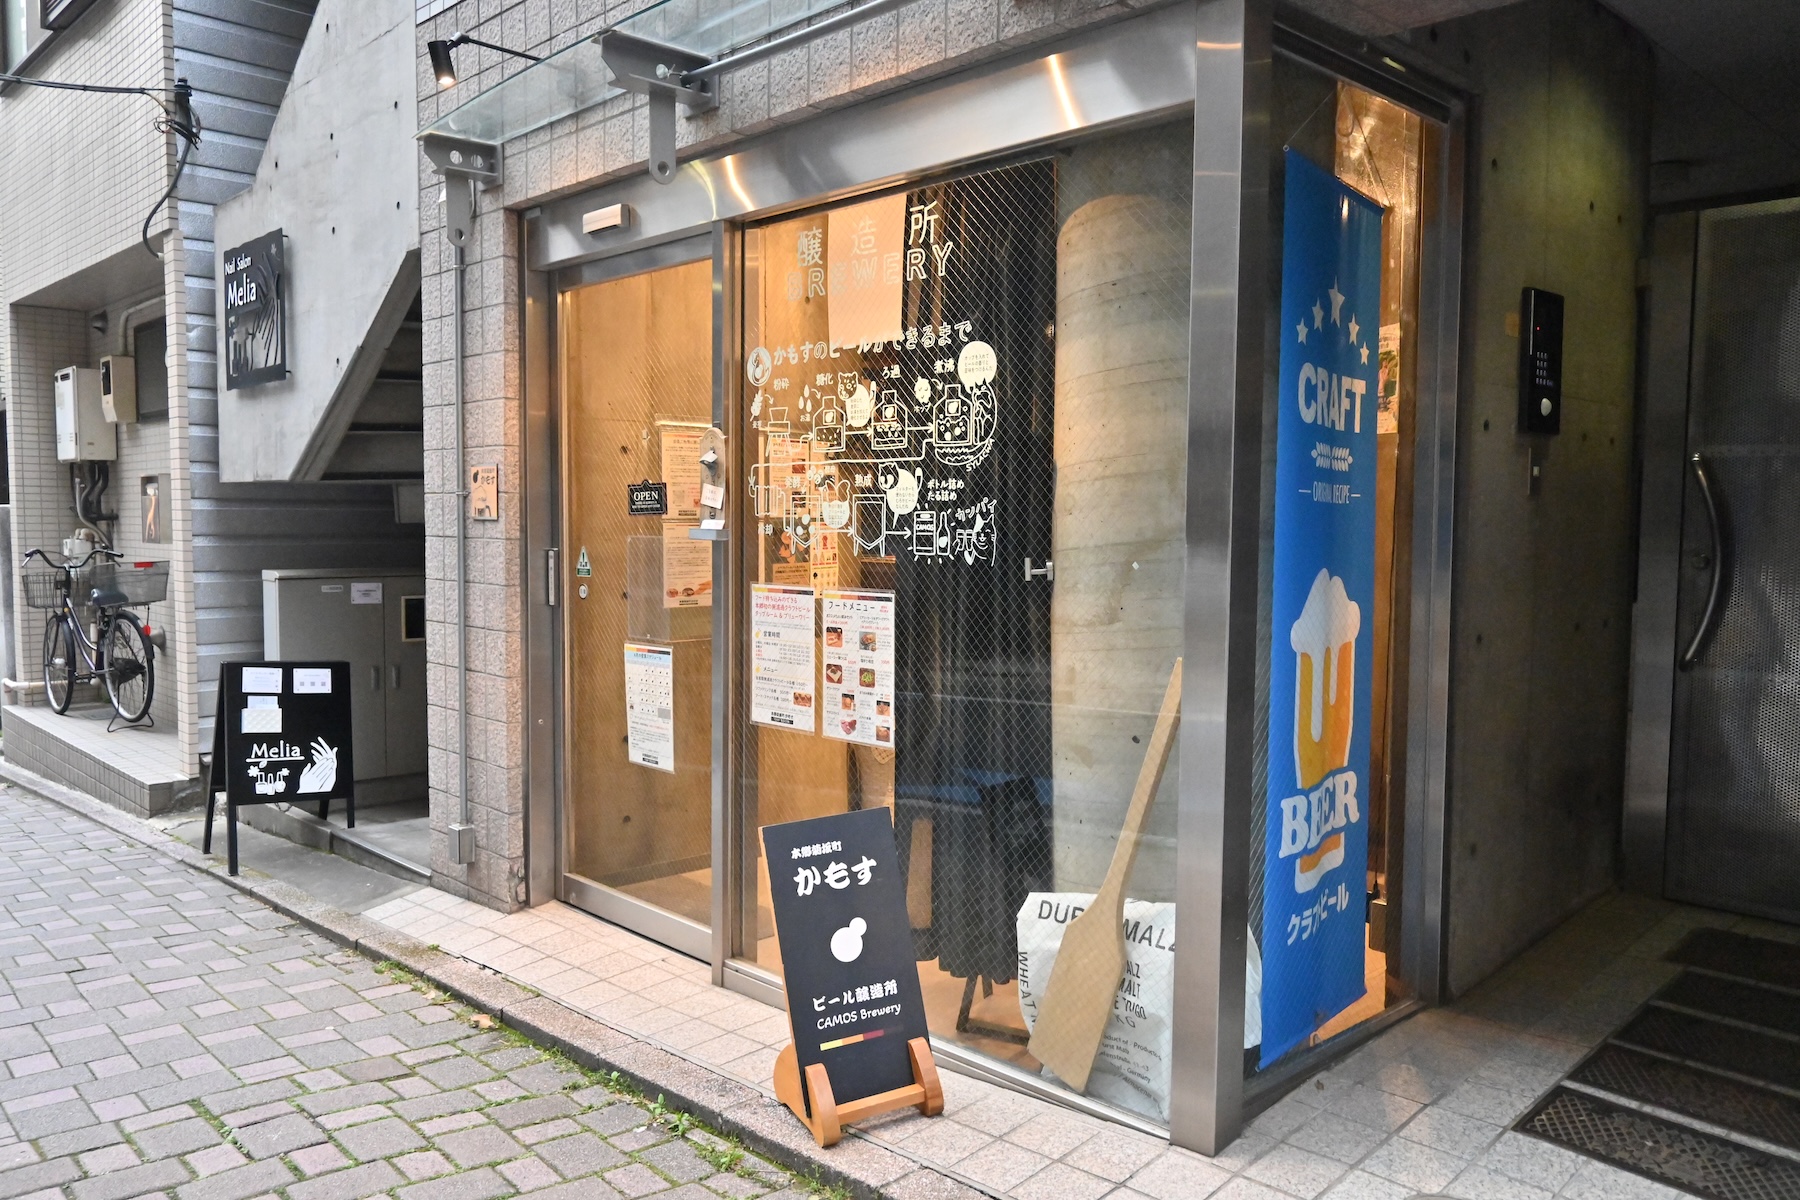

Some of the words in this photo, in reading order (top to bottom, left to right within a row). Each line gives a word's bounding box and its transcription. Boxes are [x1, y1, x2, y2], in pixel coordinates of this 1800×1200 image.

[224, 259, 235, 276] Nail
[236, 253, 252, 271] Salon
[787, 242, 953, 302] BREWERY
[227, 272, 257, 310] Melia
[1297, 362, 1367, 434] CRAFT
[633, 491, 659, 501] OPEN
[1333, 484, 1351, 504] RECIPE
[828, 600, 876, 612] フードメニュー
[250, 739, 301, 759] Melia
[1278, 771, 1360, 859] BEER
[793, 855, 878, 897] かもす
[812, 979, 898, 1012] ビール醸造所
[816, 1010, 858, 1030] CAMOS
[860, 1003, 902, 1020] Brewery
